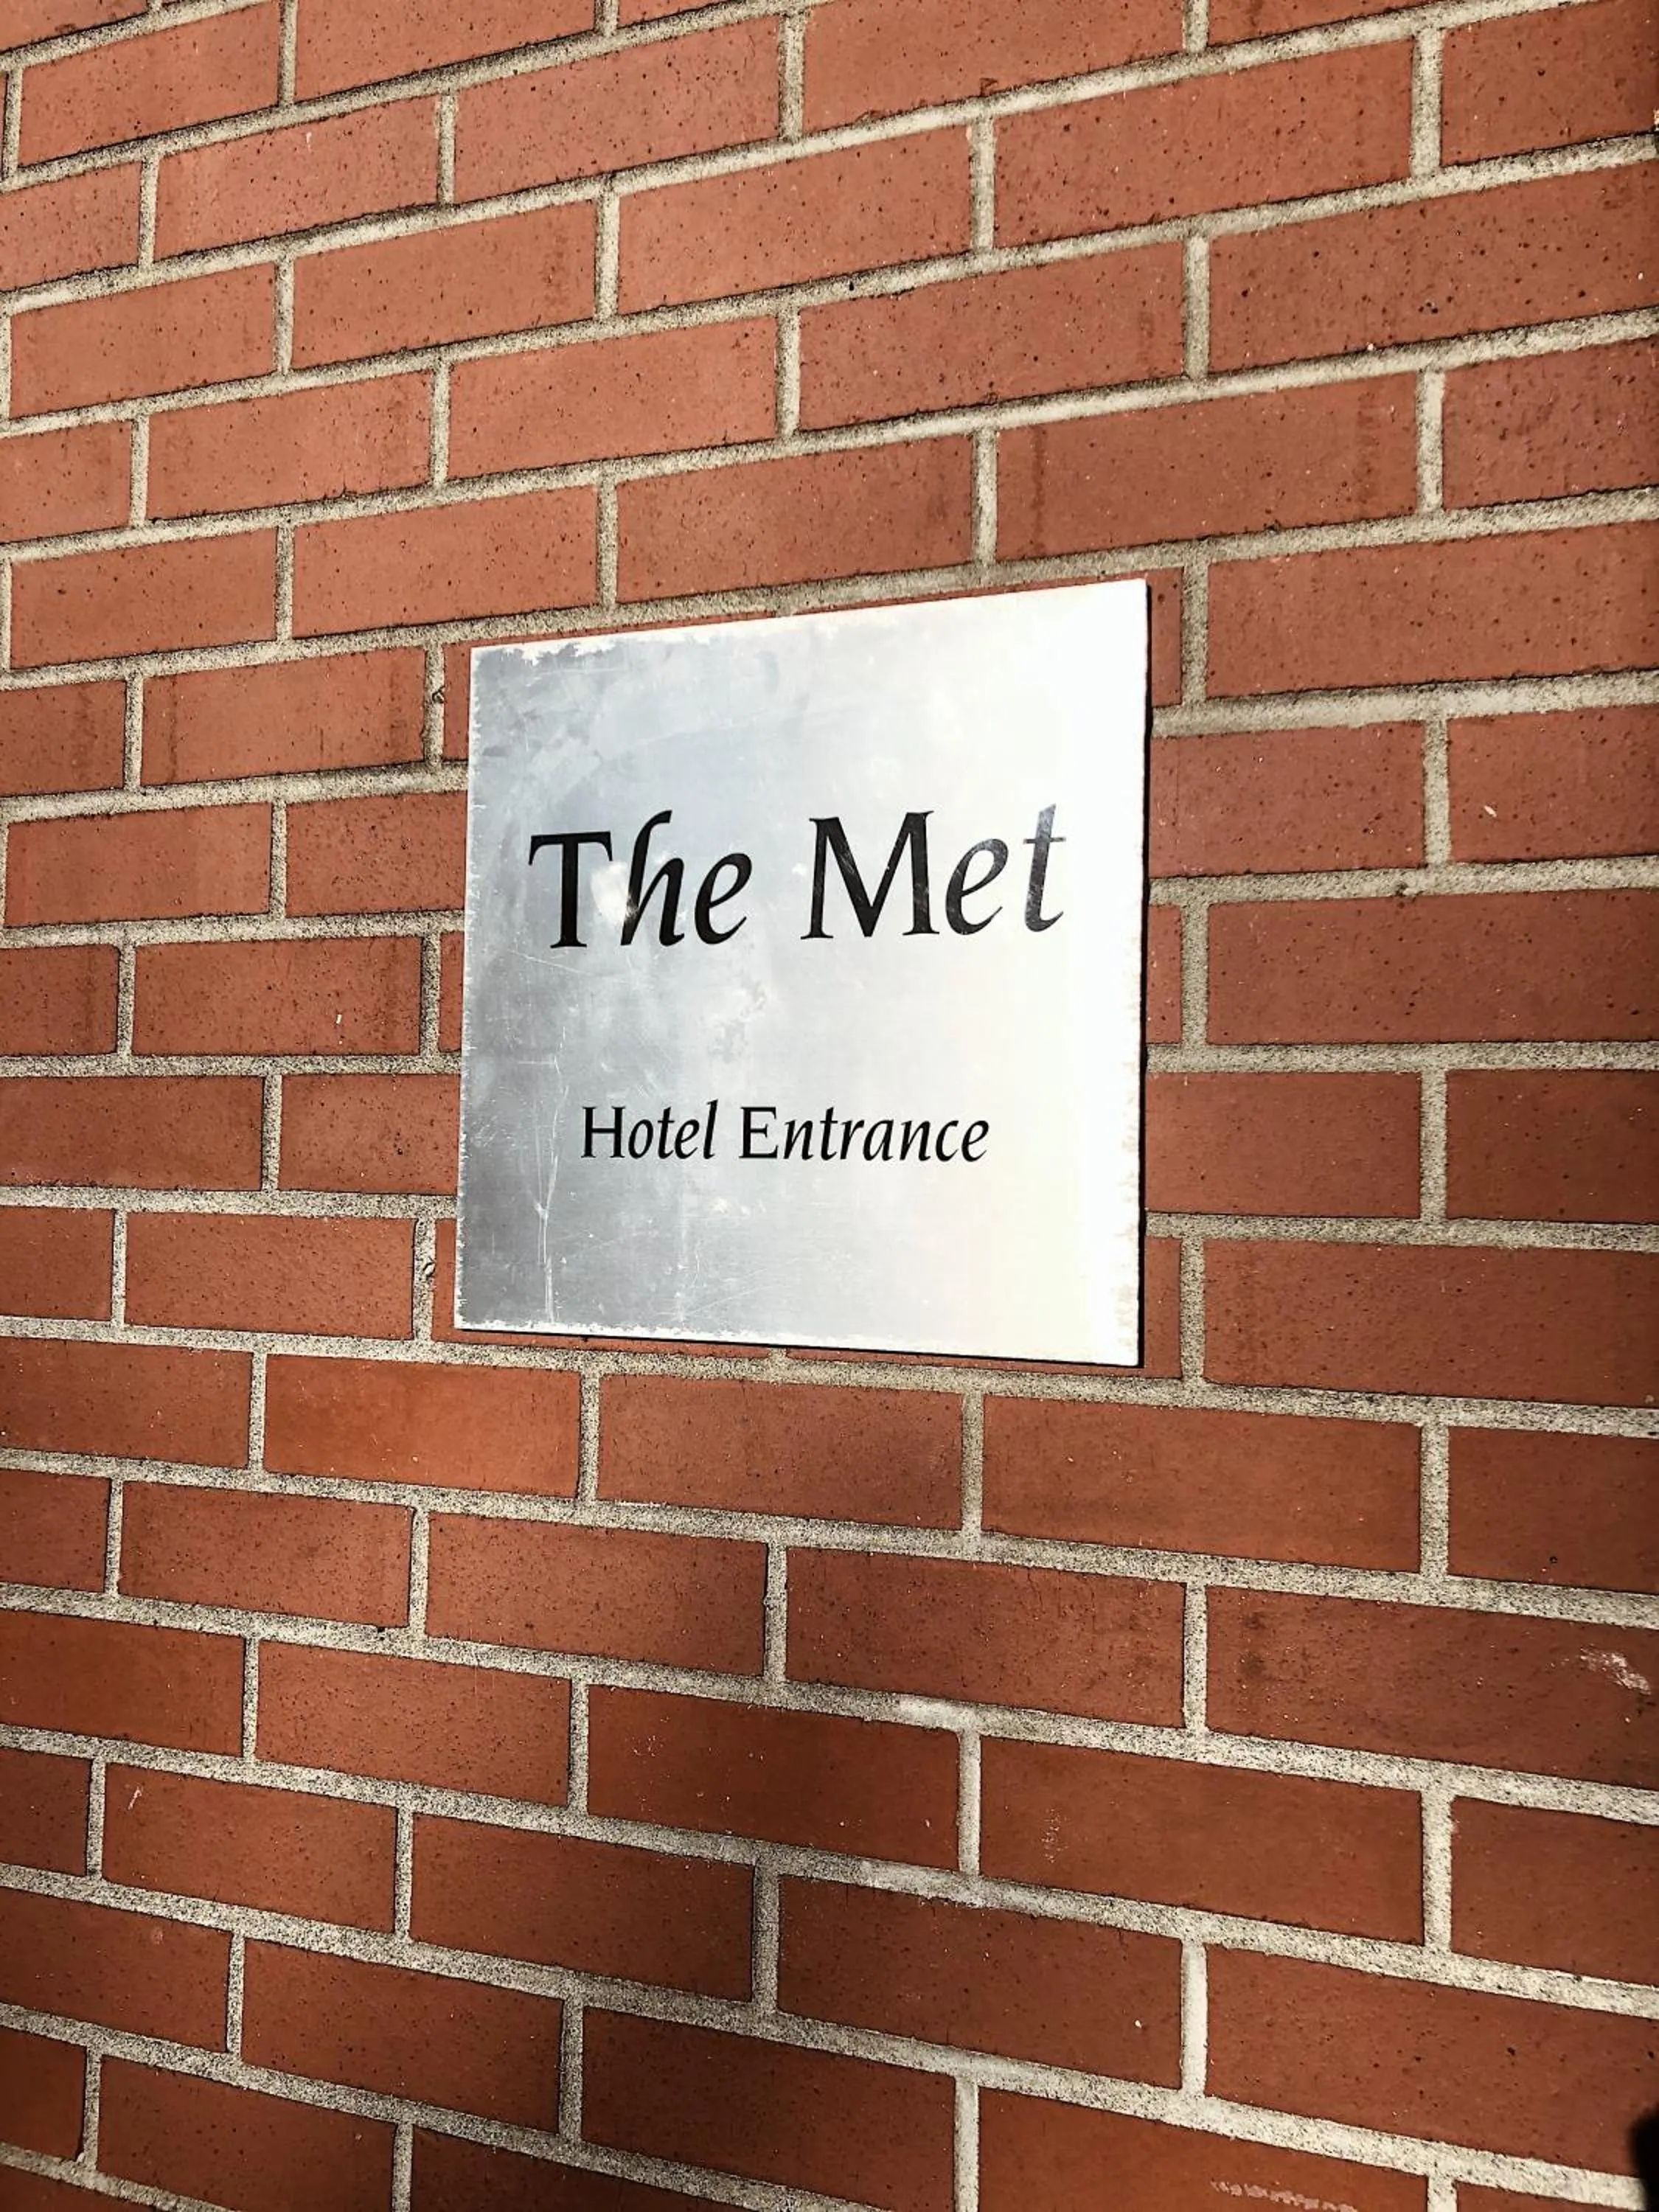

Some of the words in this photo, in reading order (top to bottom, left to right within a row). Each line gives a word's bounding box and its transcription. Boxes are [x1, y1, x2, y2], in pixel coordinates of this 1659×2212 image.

[529, 810, 753, 950] The
[800, 804, 1067, 940] Met
[580, 1099, 719, 1161] Hotel
[738, 1106, 990, 1163] Entrance
